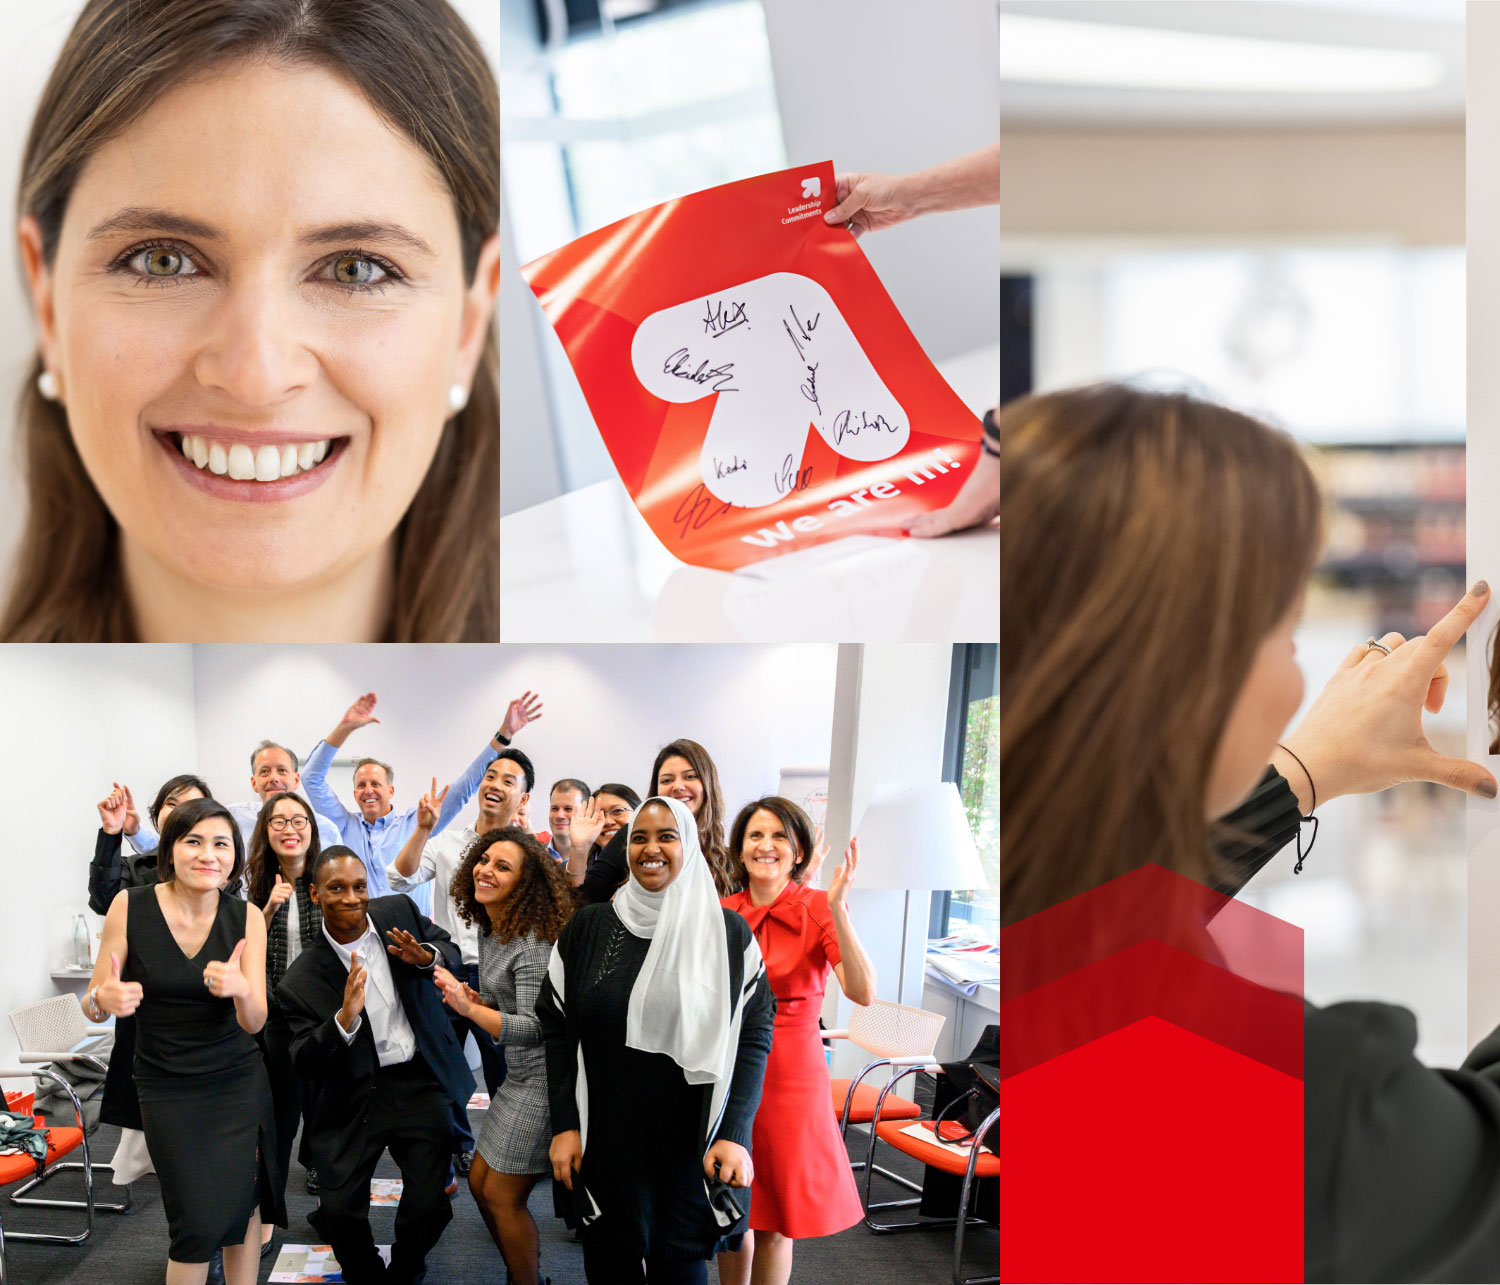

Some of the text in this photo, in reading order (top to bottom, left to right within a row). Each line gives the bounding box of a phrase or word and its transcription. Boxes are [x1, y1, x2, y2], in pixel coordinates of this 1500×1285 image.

[787, 200, 821, 214] Leadership
[781, 209, 822, 224] Commitments
[740, 447, 961, 548] We are in!
